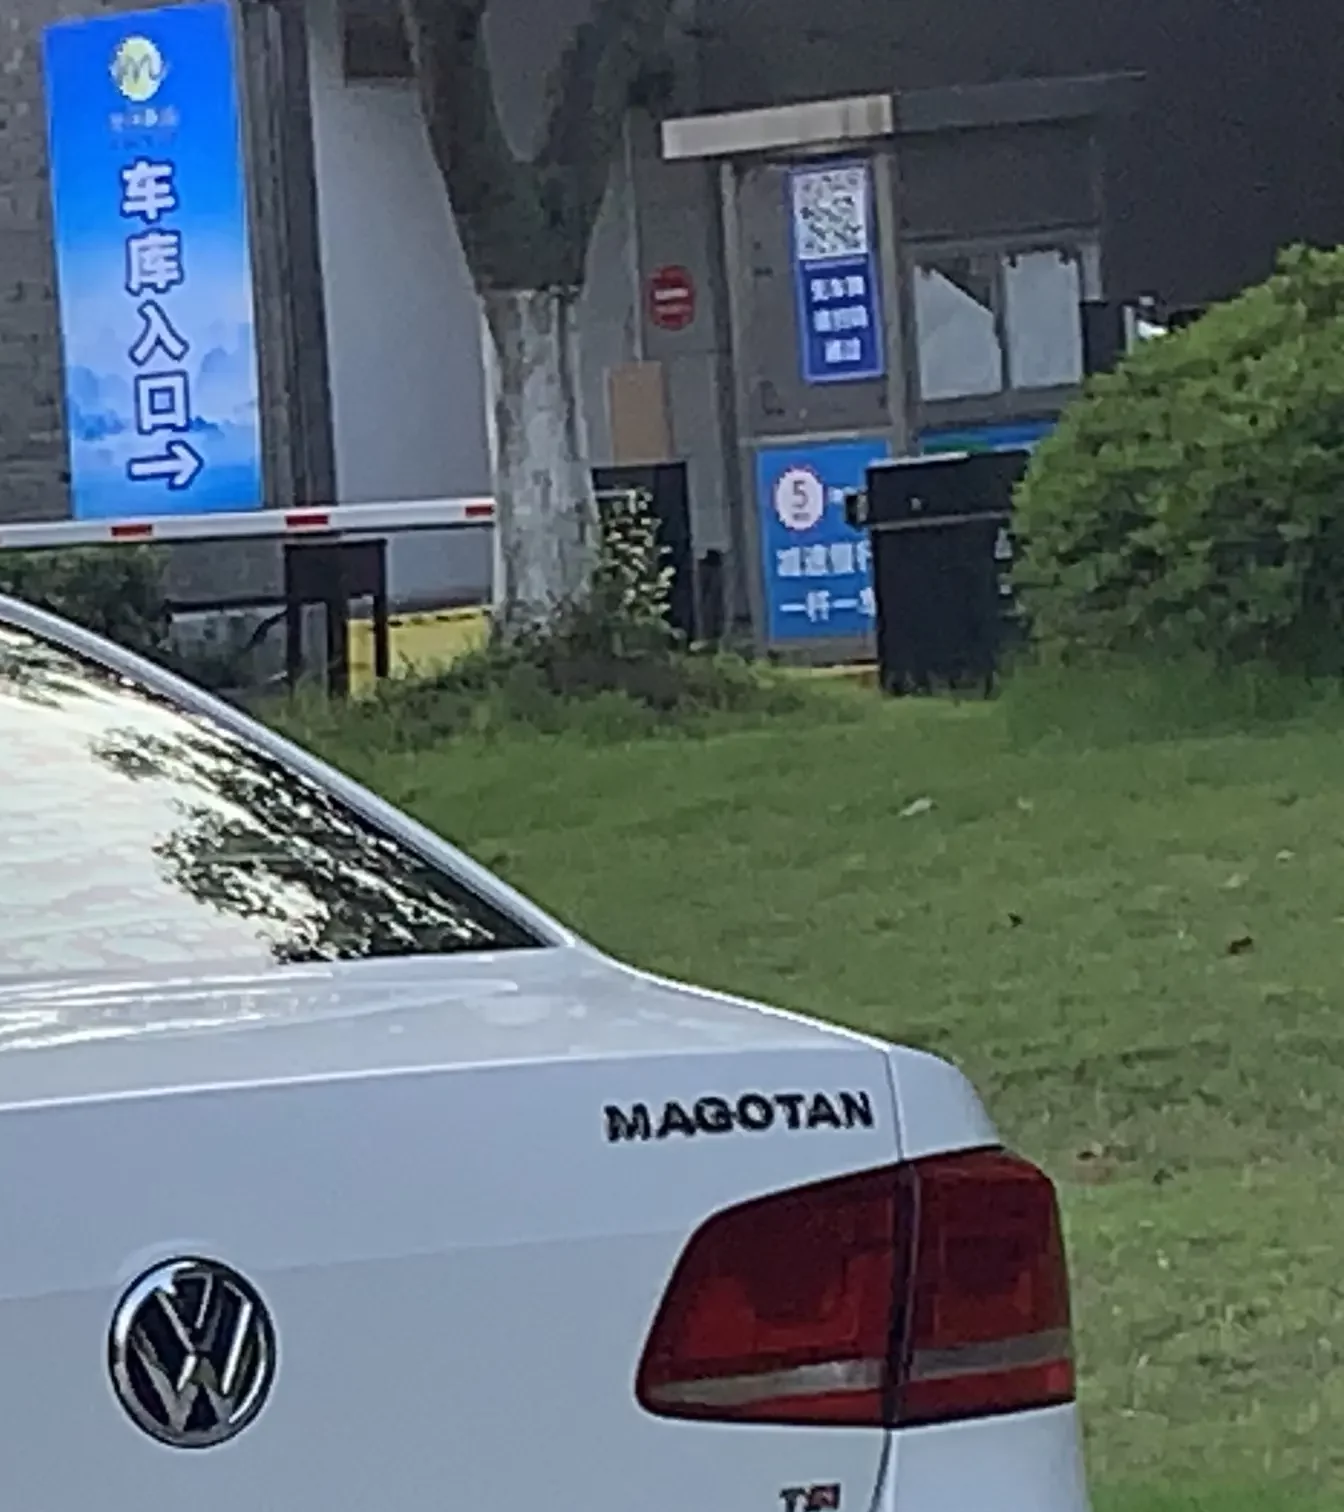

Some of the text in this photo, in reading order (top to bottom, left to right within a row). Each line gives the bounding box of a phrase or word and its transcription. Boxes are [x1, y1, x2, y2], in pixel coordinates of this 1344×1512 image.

[120, 157, 190, 434] 车库入口
[791, 479, 810, 508] 5
[604, 1091, 874, 1142] MAGOTAN
